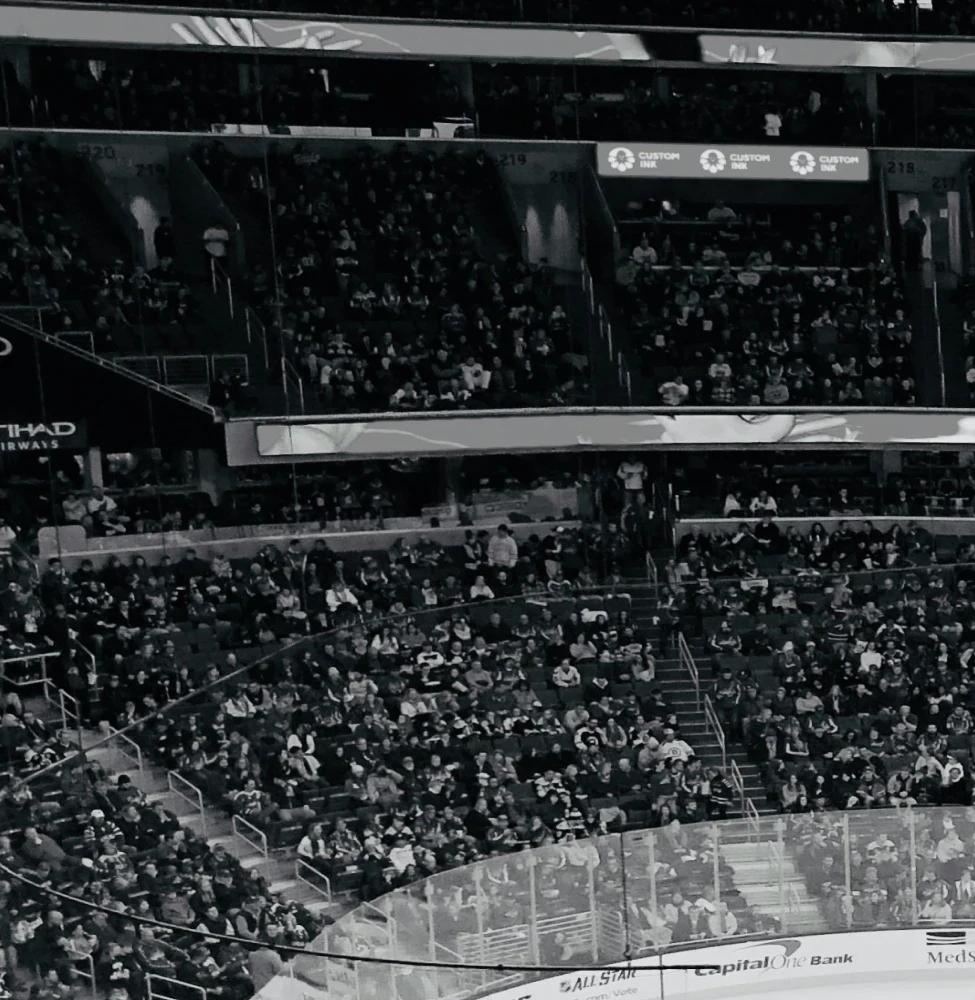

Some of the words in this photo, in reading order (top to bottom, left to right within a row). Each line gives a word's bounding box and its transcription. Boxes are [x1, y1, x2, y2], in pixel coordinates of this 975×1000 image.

[638, 152, 680, 160] CUSTOM
[729, 153, 771, 162] CUSTOM
[819, 156, 859, 164] CUSTOM
[640, 160, 657, 168] INK
[731, 162, 748, 170] INK
[820, 164, 837, 172] INK
[887, 162, 915, 174] 218
[932, 177, 957, 189] 217
[810, 953, 853, 966] Bank
